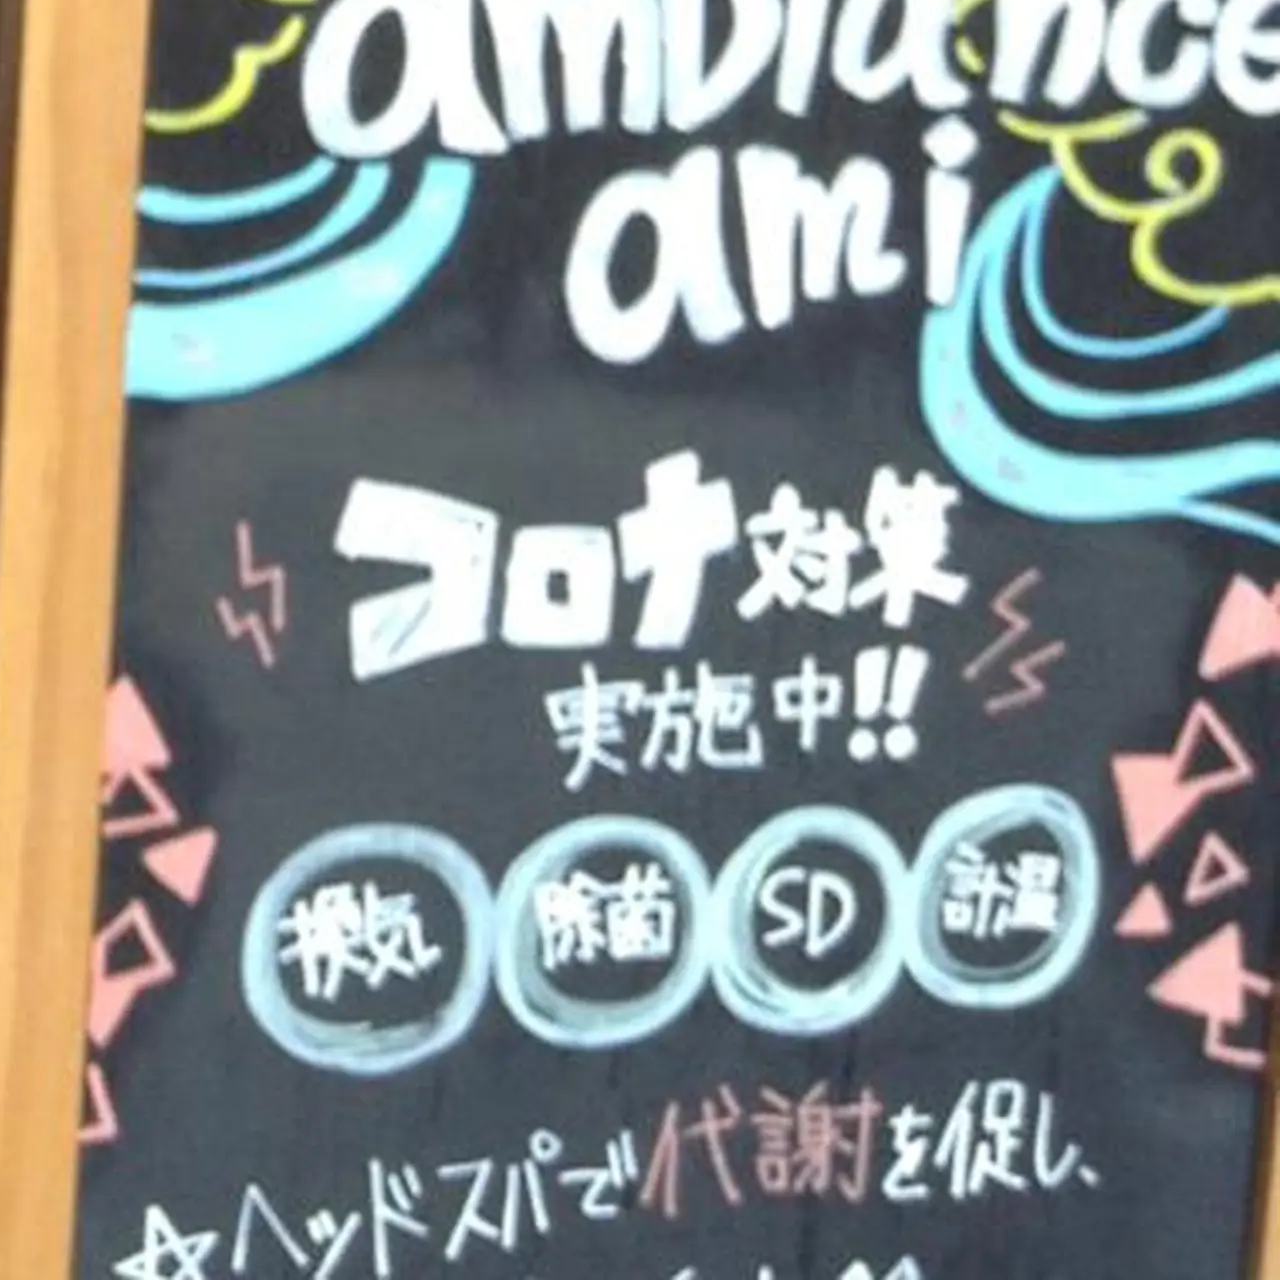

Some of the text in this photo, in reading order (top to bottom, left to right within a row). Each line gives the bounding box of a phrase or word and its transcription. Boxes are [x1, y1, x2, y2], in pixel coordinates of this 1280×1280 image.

[565, 114, 977, 364] ami
[333, 448, 970, 683] コロナ対策
[534, 862, 674, 970] 除菌
[759, 867, 858, 958] SD
